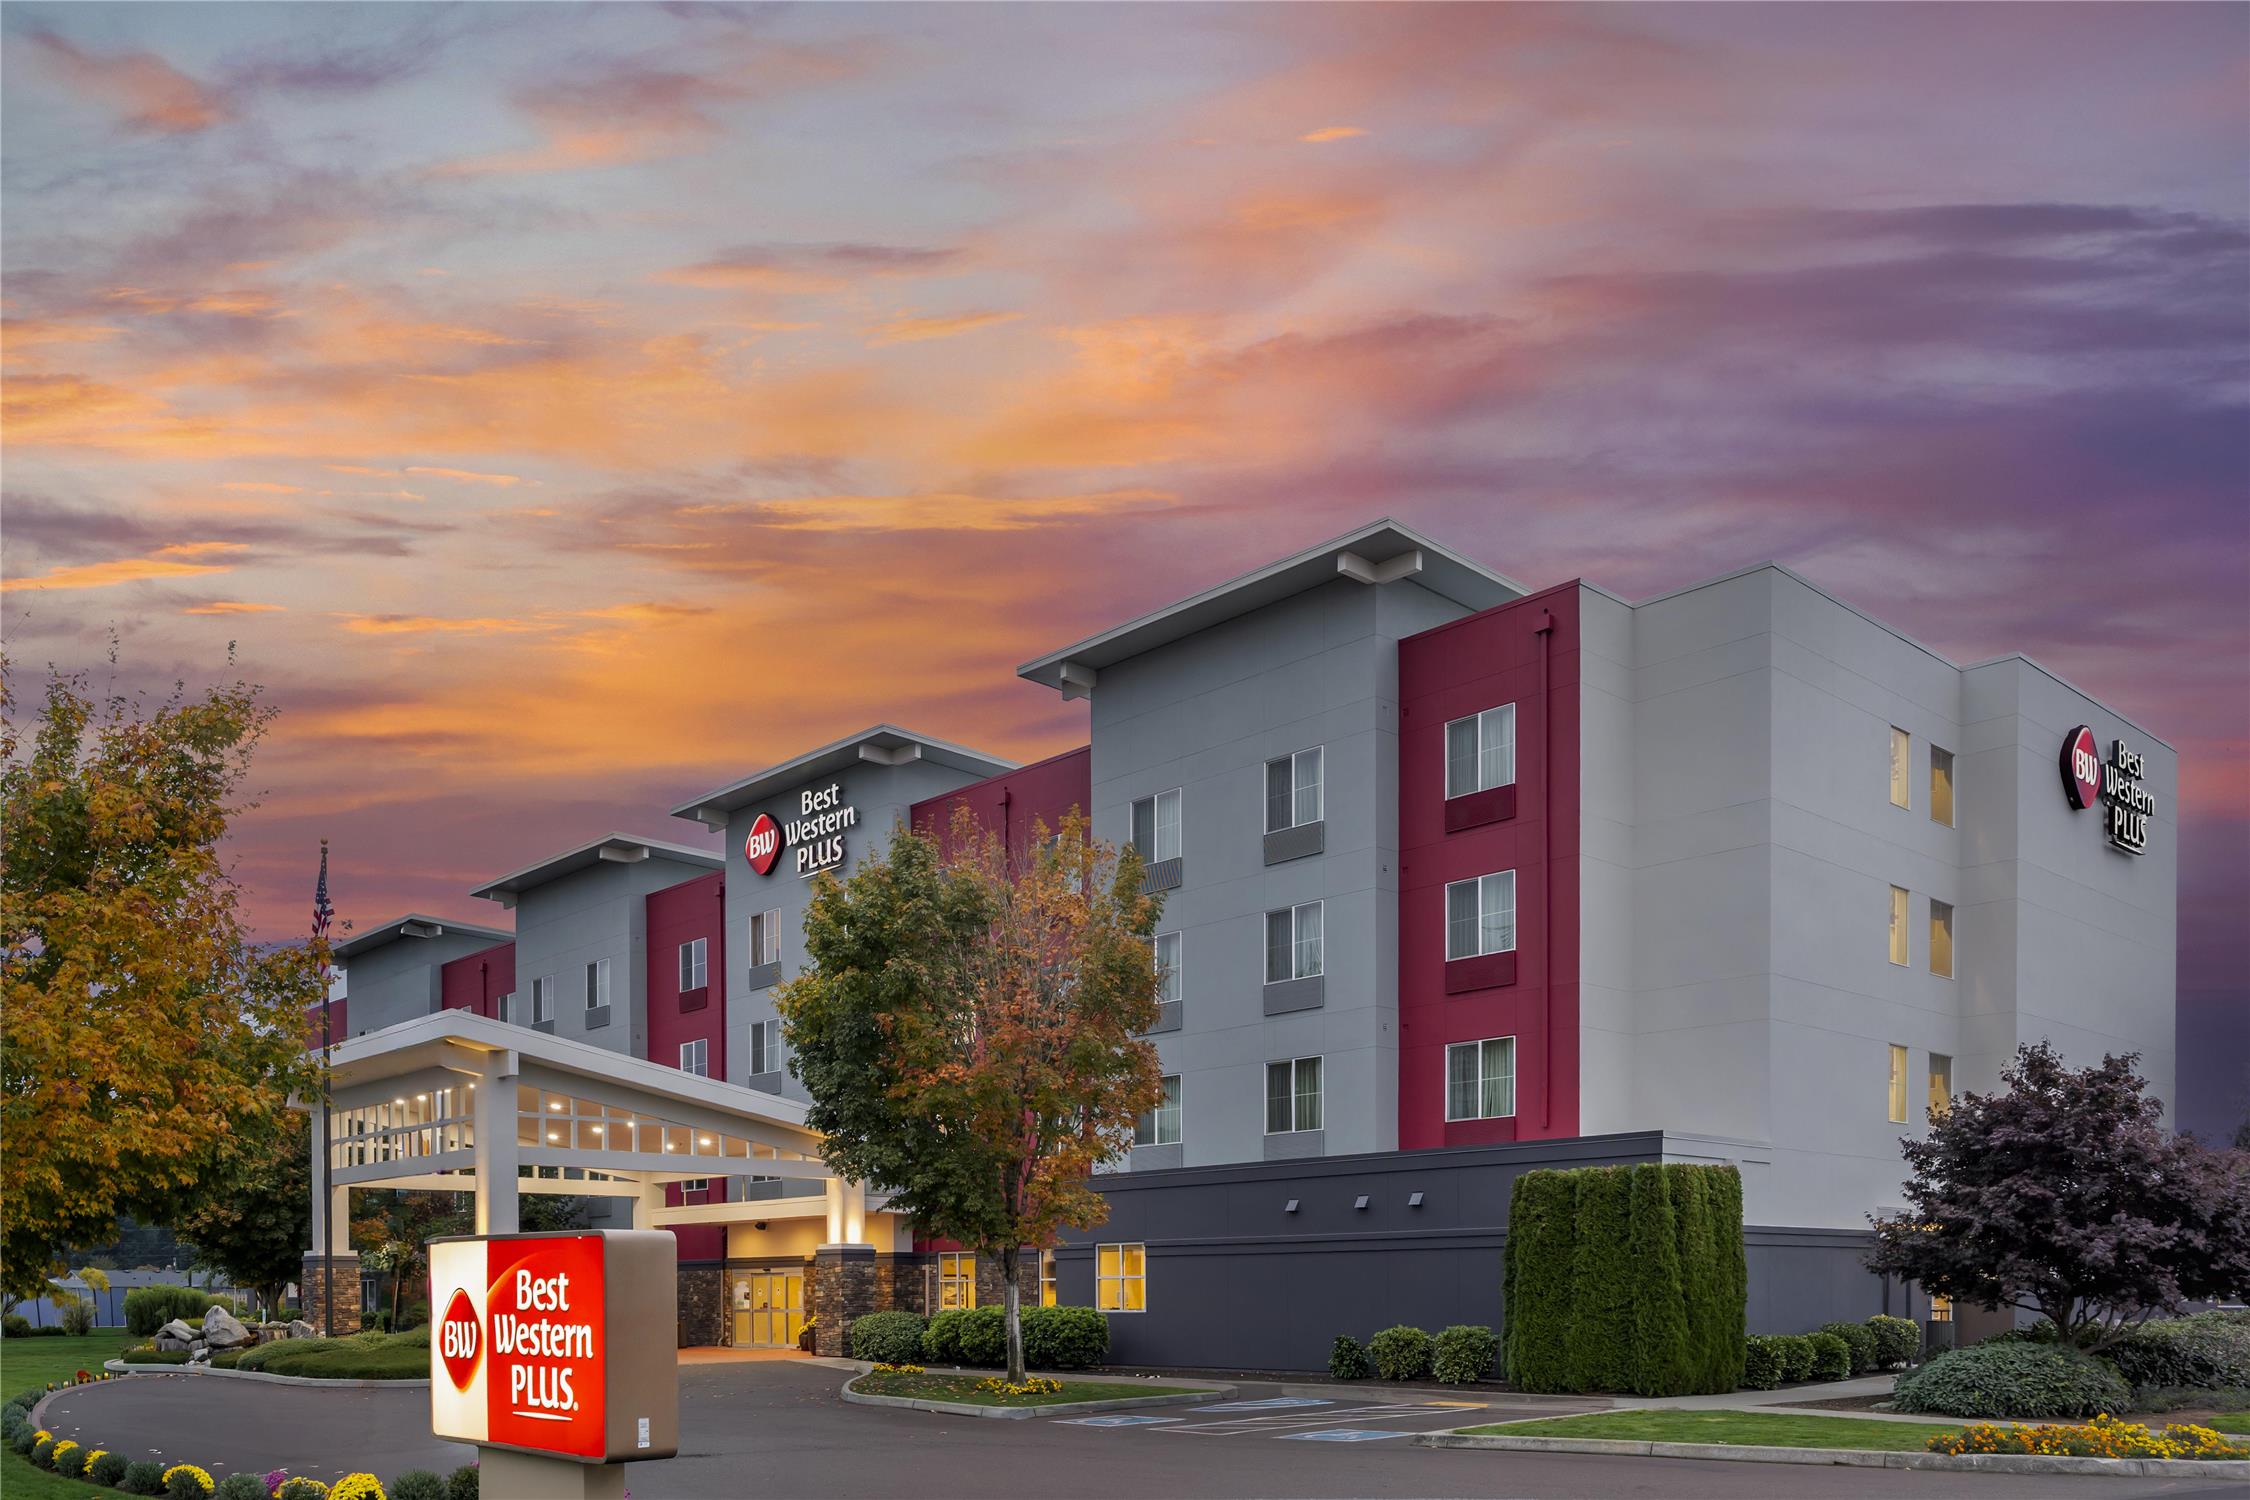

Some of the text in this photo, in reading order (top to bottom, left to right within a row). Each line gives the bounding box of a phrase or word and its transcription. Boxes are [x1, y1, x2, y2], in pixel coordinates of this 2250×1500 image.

[2075, 748, 2098, 786] BW
[2118, 739, 2145, 779] Best
[801, 783, 839, 815] Best
[2105, 763, 2155, 816] Western
[749, 829, 775, 859] BW
[785, 806, 855, 847] Western
[2114, 805, 2147, 848] PLUS
[797, 835, 843, 872] PLUS
[516, 1269, 570, 1312] Best
[444, 1320, 477, 1359] BW
[493, 1313, 594, 1359] Western
